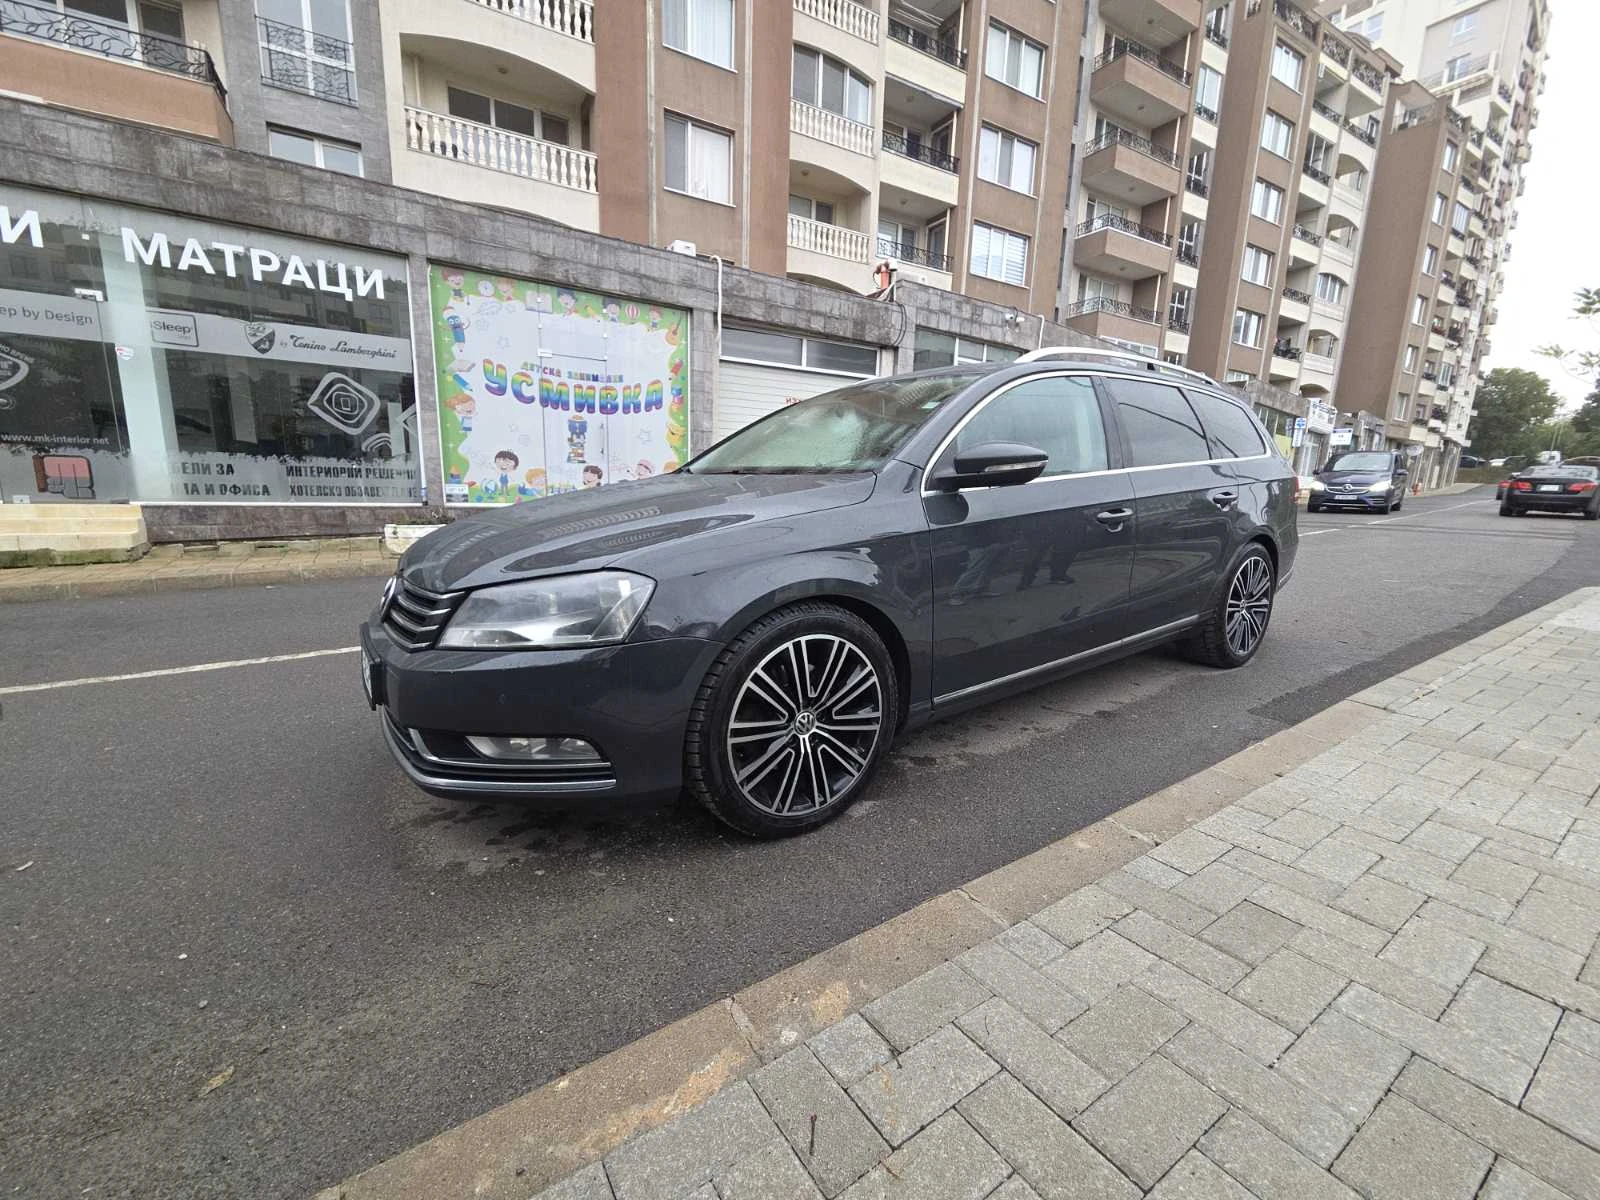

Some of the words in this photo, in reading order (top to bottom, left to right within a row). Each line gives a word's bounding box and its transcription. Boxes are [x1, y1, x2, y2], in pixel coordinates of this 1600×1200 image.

[0, 205, 44, 248] И
[121, 227, 385, 302] МАТРАЦИ
[22, 307, 40, 321] by
[44, 309, 93, 326] Design
[153, 320, 191, 335] Sleep
[290, 334, 326, 351] Tonino
[329, 340, 396, 359] Lamborghini
[482, 358, 664, 416] УСМИВКА
[216, 463, 235, 475] ЗА
[220, 484, 271, 497] ОФИСА
